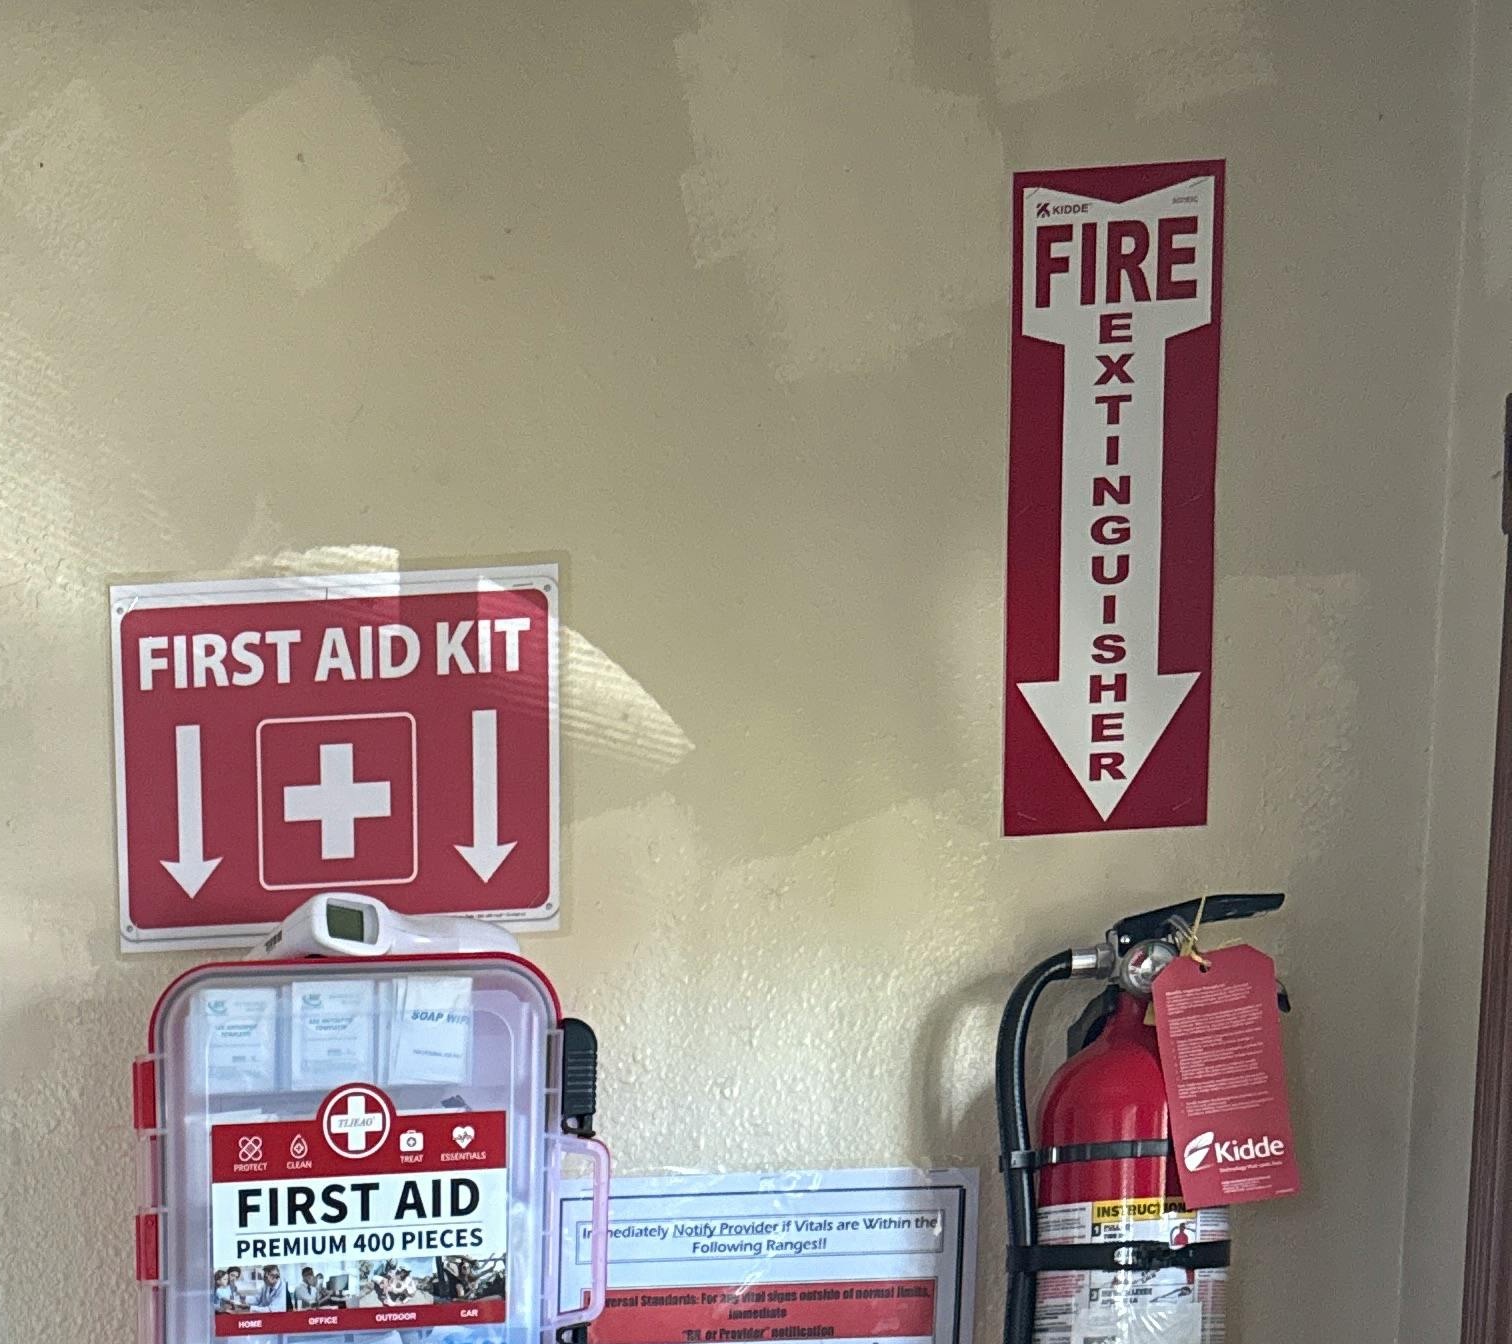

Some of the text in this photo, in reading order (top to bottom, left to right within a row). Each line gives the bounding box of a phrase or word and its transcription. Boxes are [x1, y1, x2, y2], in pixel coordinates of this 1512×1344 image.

[1052, 203, 1089, 215] KIDDE
[1035, 216, 1198, 308] FIRE
[1089, 313, 1134, 782] EXTINGUISHER
[139, 617, 531, 690] FIRST AID KIT
[411, 1011, 444, 1022] SOAP
[1214, 1136, 1284, 1163] Kidde
[400, 1154, 423, 1163] TREAT
[441, 1151, 486, 1161] ESSENTIALS
[233, 1162, 267, 1172] PROTECT
[286, 1161, 312, 1169] CLEAN
[238, 1178, 479, 1228] FIRST AID
[674, 1223, 716, 1238] Notify
[719, 1221, 779, 1235] Provider
[782, 1220, 792, 1232] if
[795, 1220, 833, 1232] Vitals
[836, 1221, 859, 1231] are
[863, 1218, 912, 1229] Within
[237, 1228, 483, 1259] PREMIUM 400 PIECES
[692, 1238, 762, 1256] Following
[375, 1312, 416, 1322] OUTDOOR
[460, 1309, 478, 1317] CAR
[238, 1320, 262, 1328] HOME
[308, 1316, 338, 1325] OFFICE
